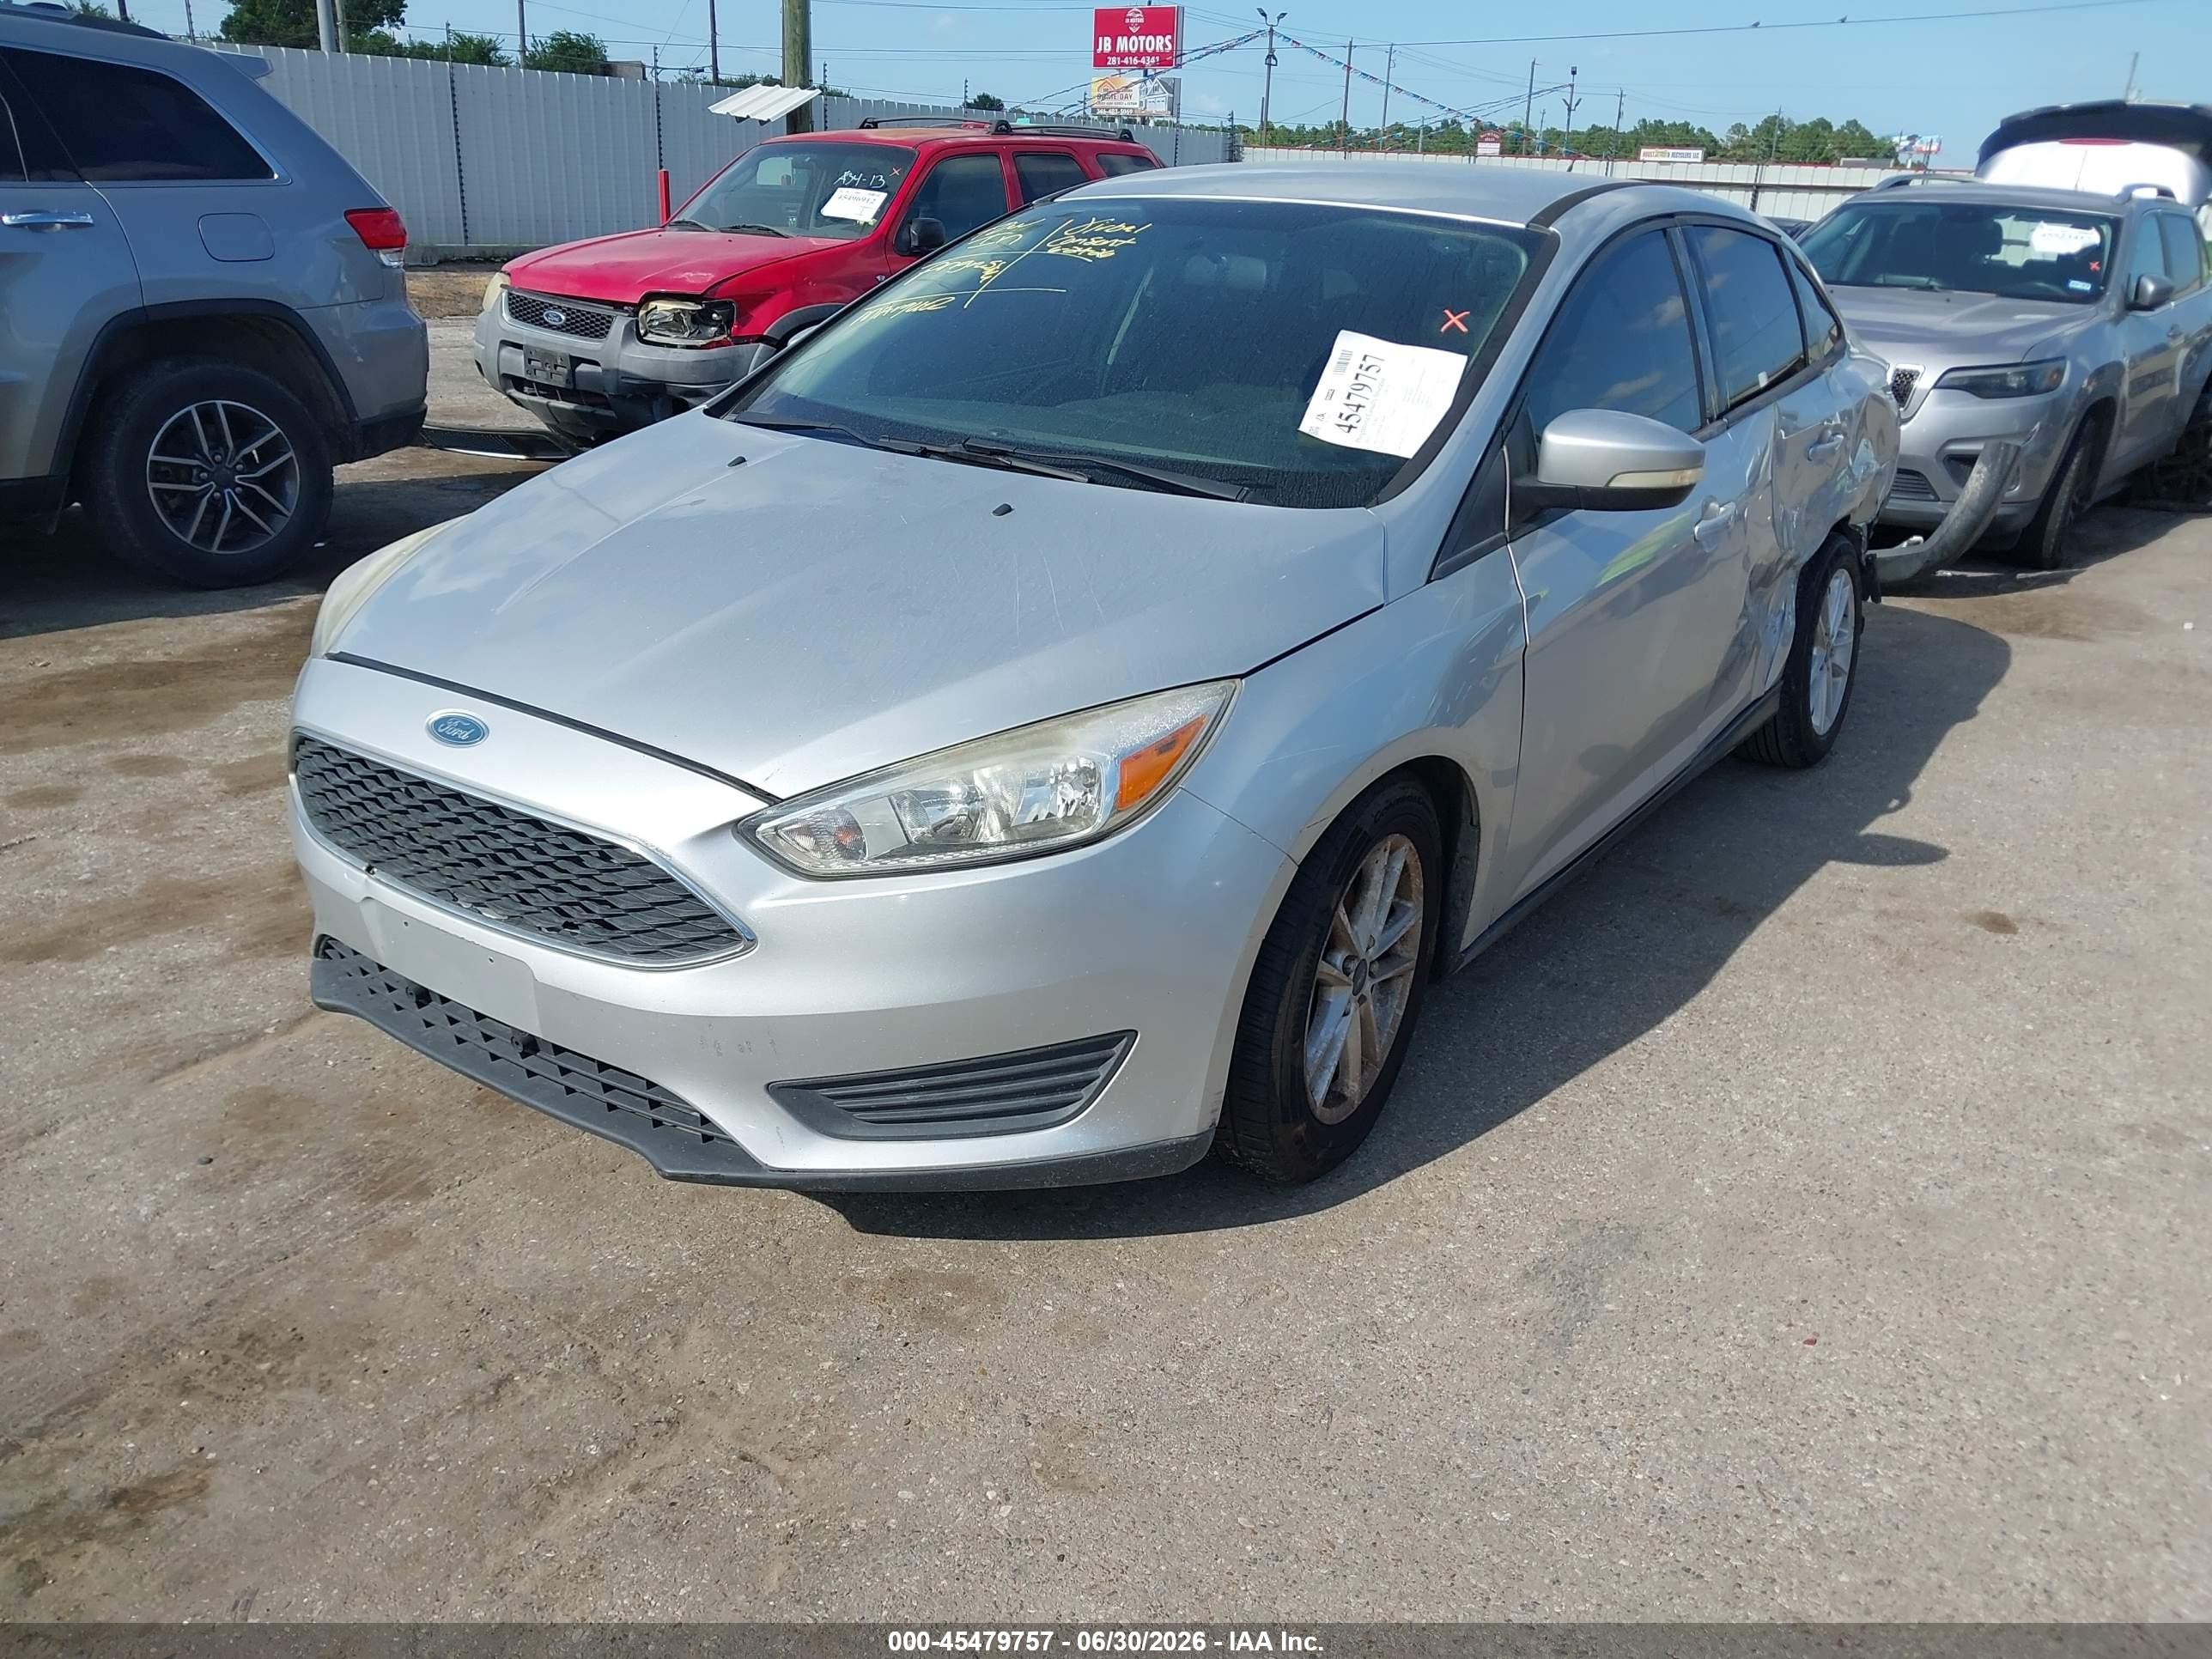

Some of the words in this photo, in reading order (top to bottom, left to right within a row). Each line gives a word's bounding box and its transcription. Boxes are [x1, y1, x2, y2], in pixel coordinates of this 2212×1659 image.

[1097, 36, 1112, 53] JB
[1116, 35, 1172, 53] MOTORS
[1107, 56, 1160, 65] 281-416-4341
[1334, 354, 1386, 434] 45479757
[438, 718, 475, 740] Ford
